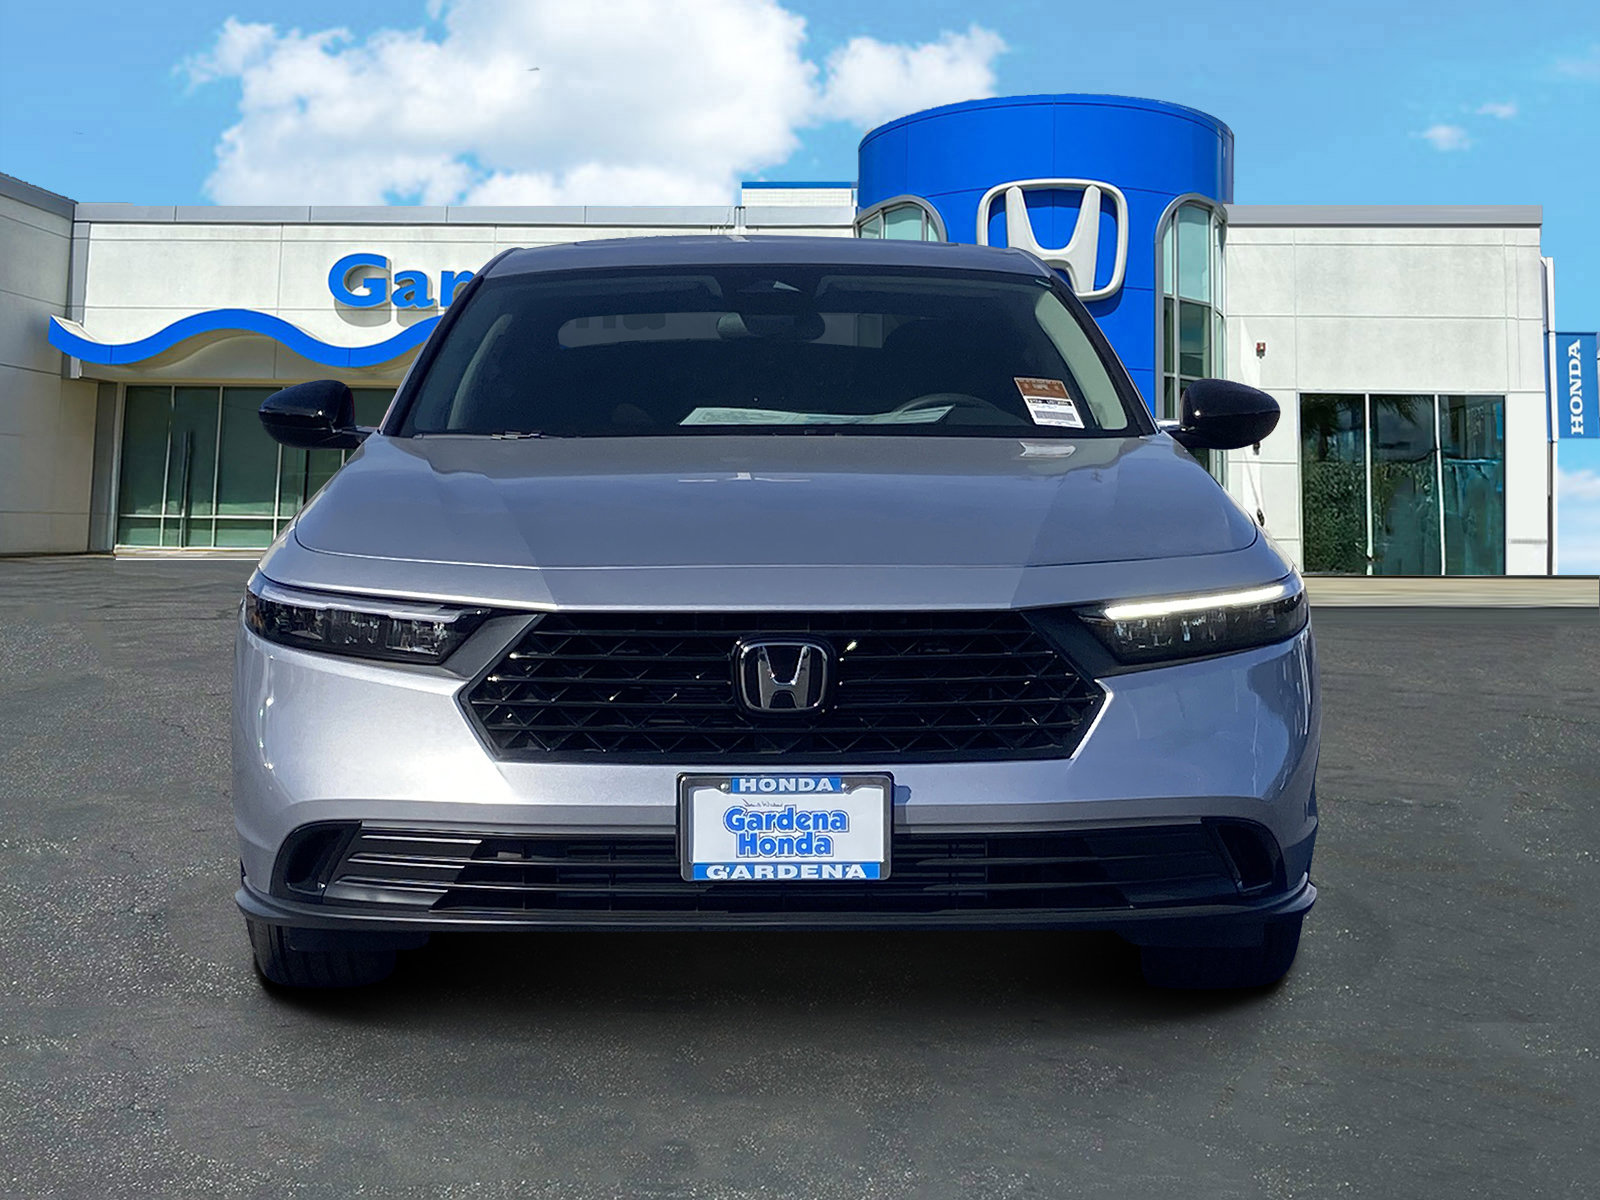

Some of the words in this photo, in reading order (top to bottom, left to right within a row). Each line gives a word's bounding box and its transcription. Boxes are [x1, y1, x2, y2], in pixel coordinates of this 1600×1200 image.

[1568, 339, 1584, 435] HONDA
[739, 777, 834, 793] HONDA
[725, 806, 848, 832] Gardena
[738, 831, 832, 856] Honda
[706, 864, 867, 880] GARDENA
